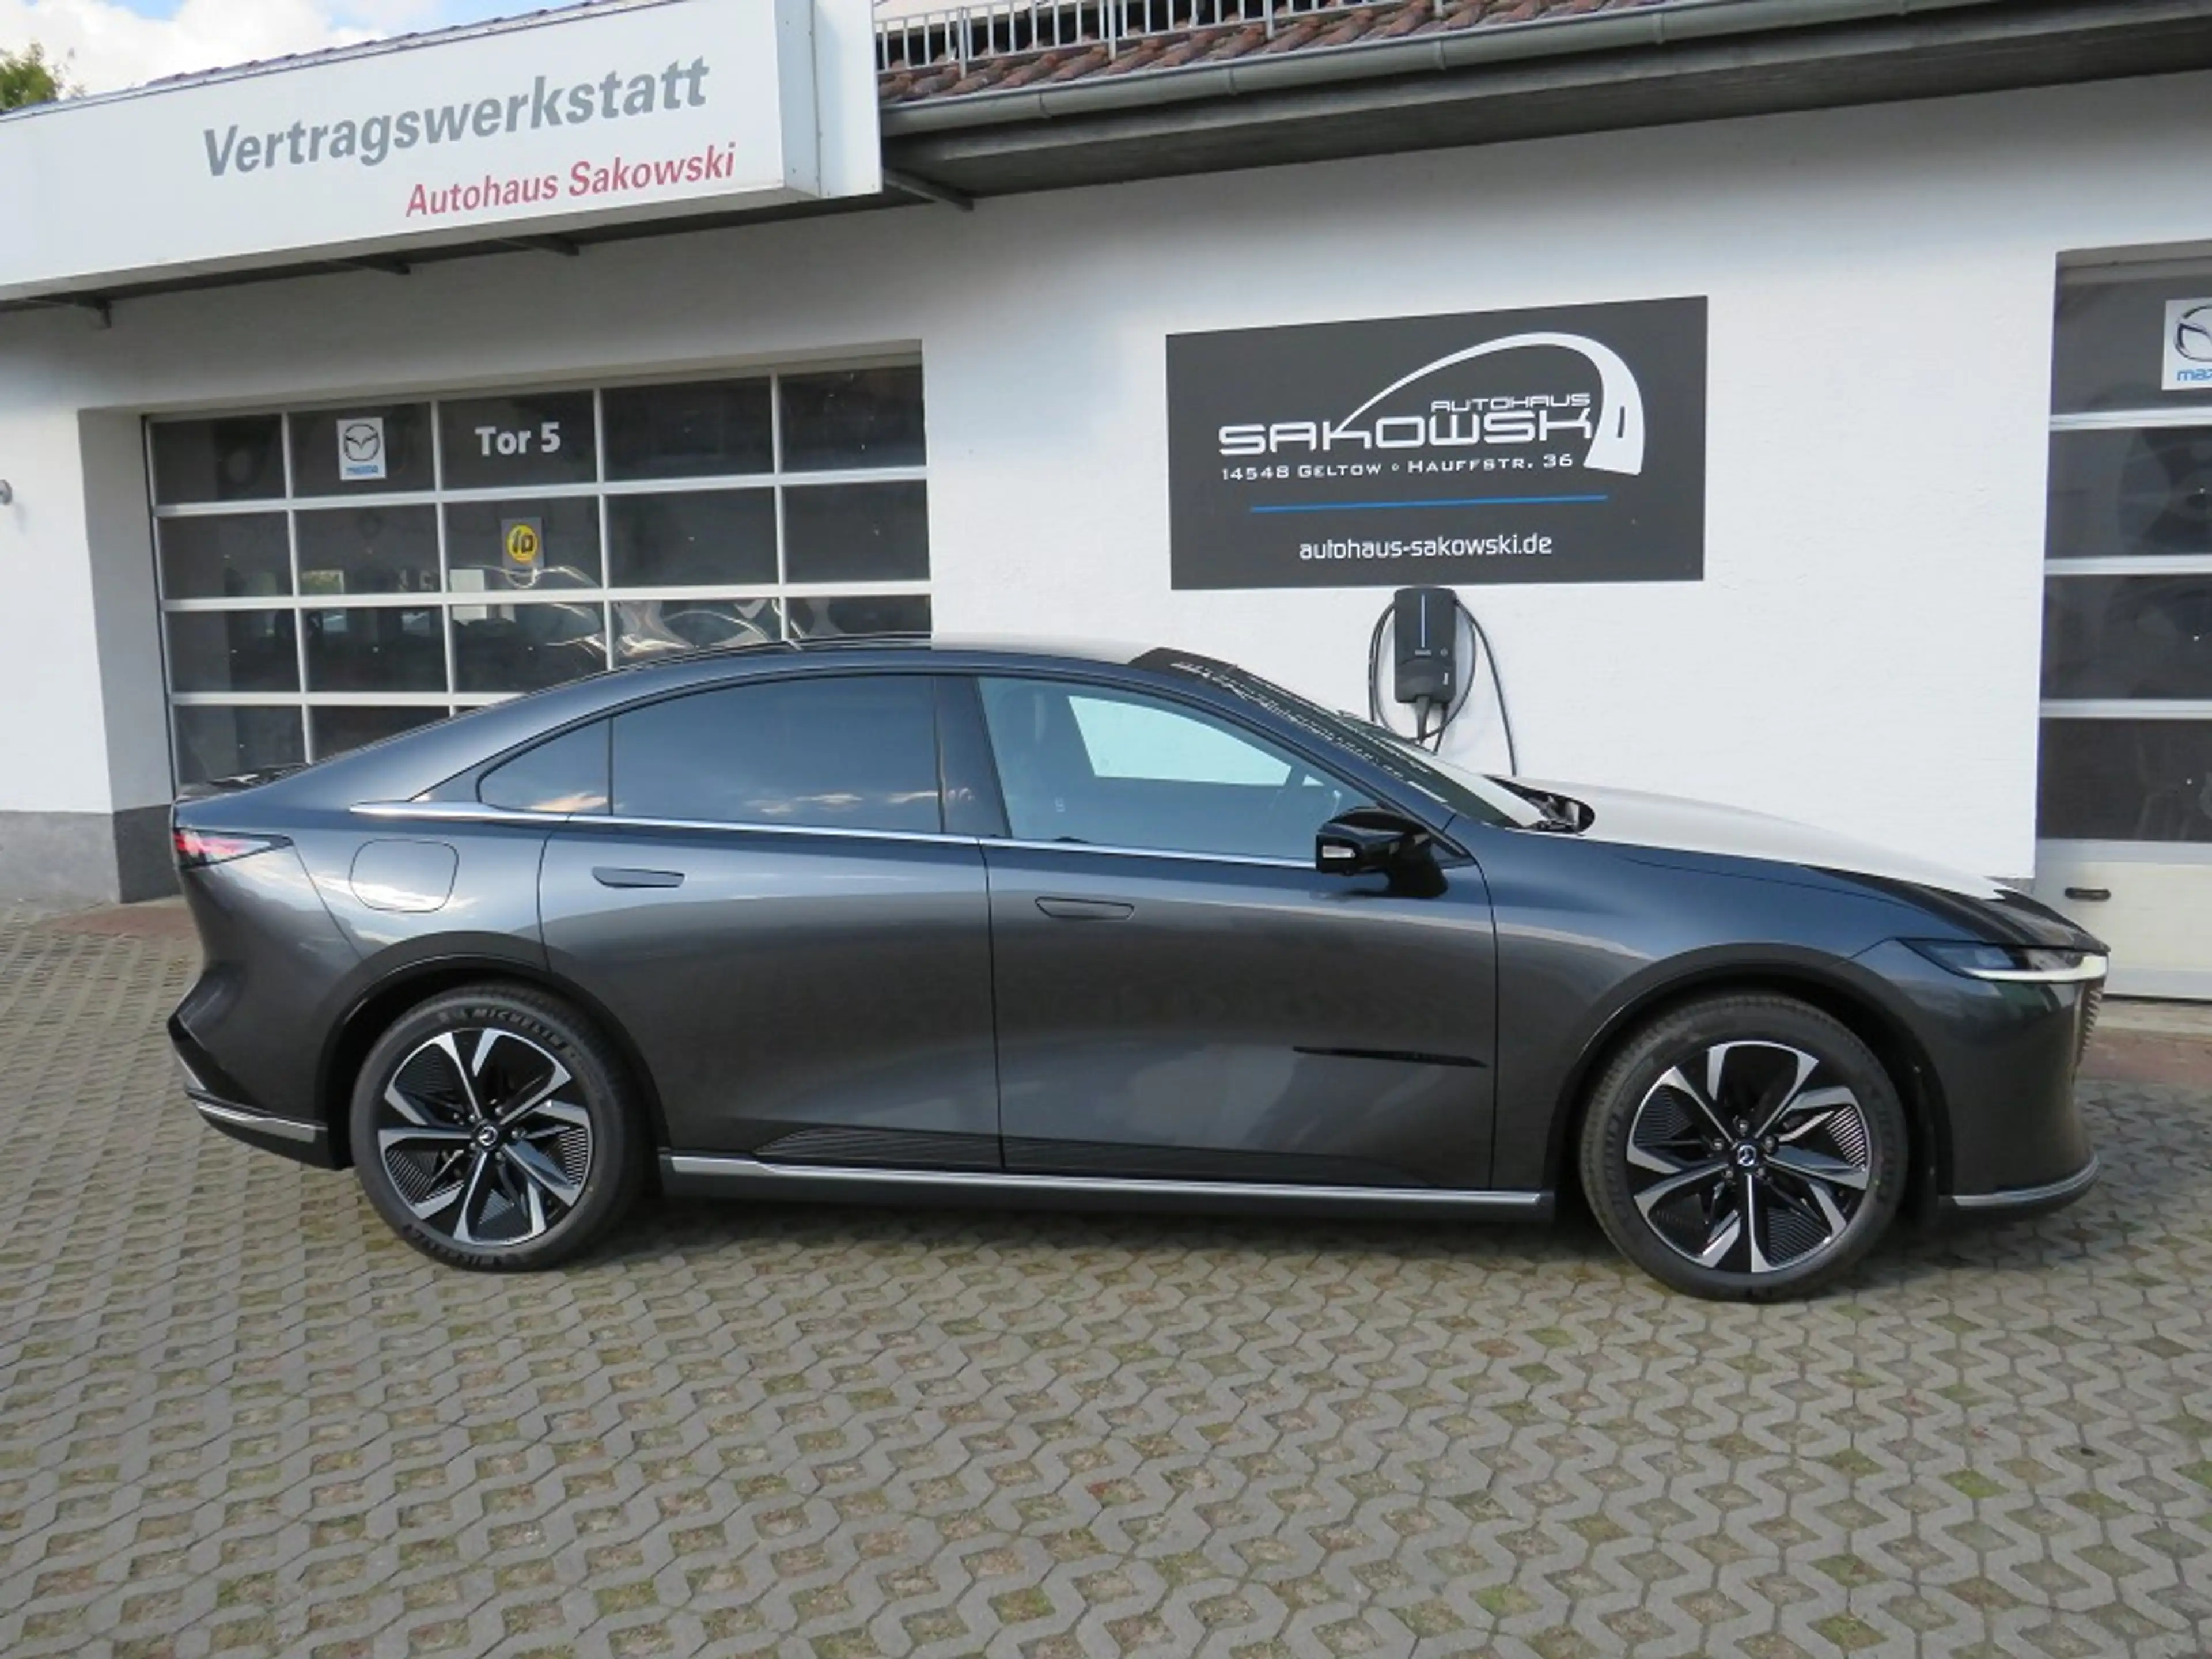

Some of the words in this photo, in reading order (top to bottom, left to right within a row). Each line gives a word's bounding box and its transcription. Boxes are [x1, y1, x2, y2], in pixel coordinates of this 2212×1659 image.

[203, 56, 710, 176] Vertragswerkstatt
[406, 183, 558, 217] Autohaus
[570, 142, 735, 196] Sakowski
[1431, 393, 1592, 412] AUTOHAUS
[475, 426, 531, 456] Tor
[541, 422, 560, 453] 5
[1222, 465, 1290, 480] 14548
[1543, 453, 1573, 468] 36
[1299, 533, 1552, 559] autohaus-sakowski.de
